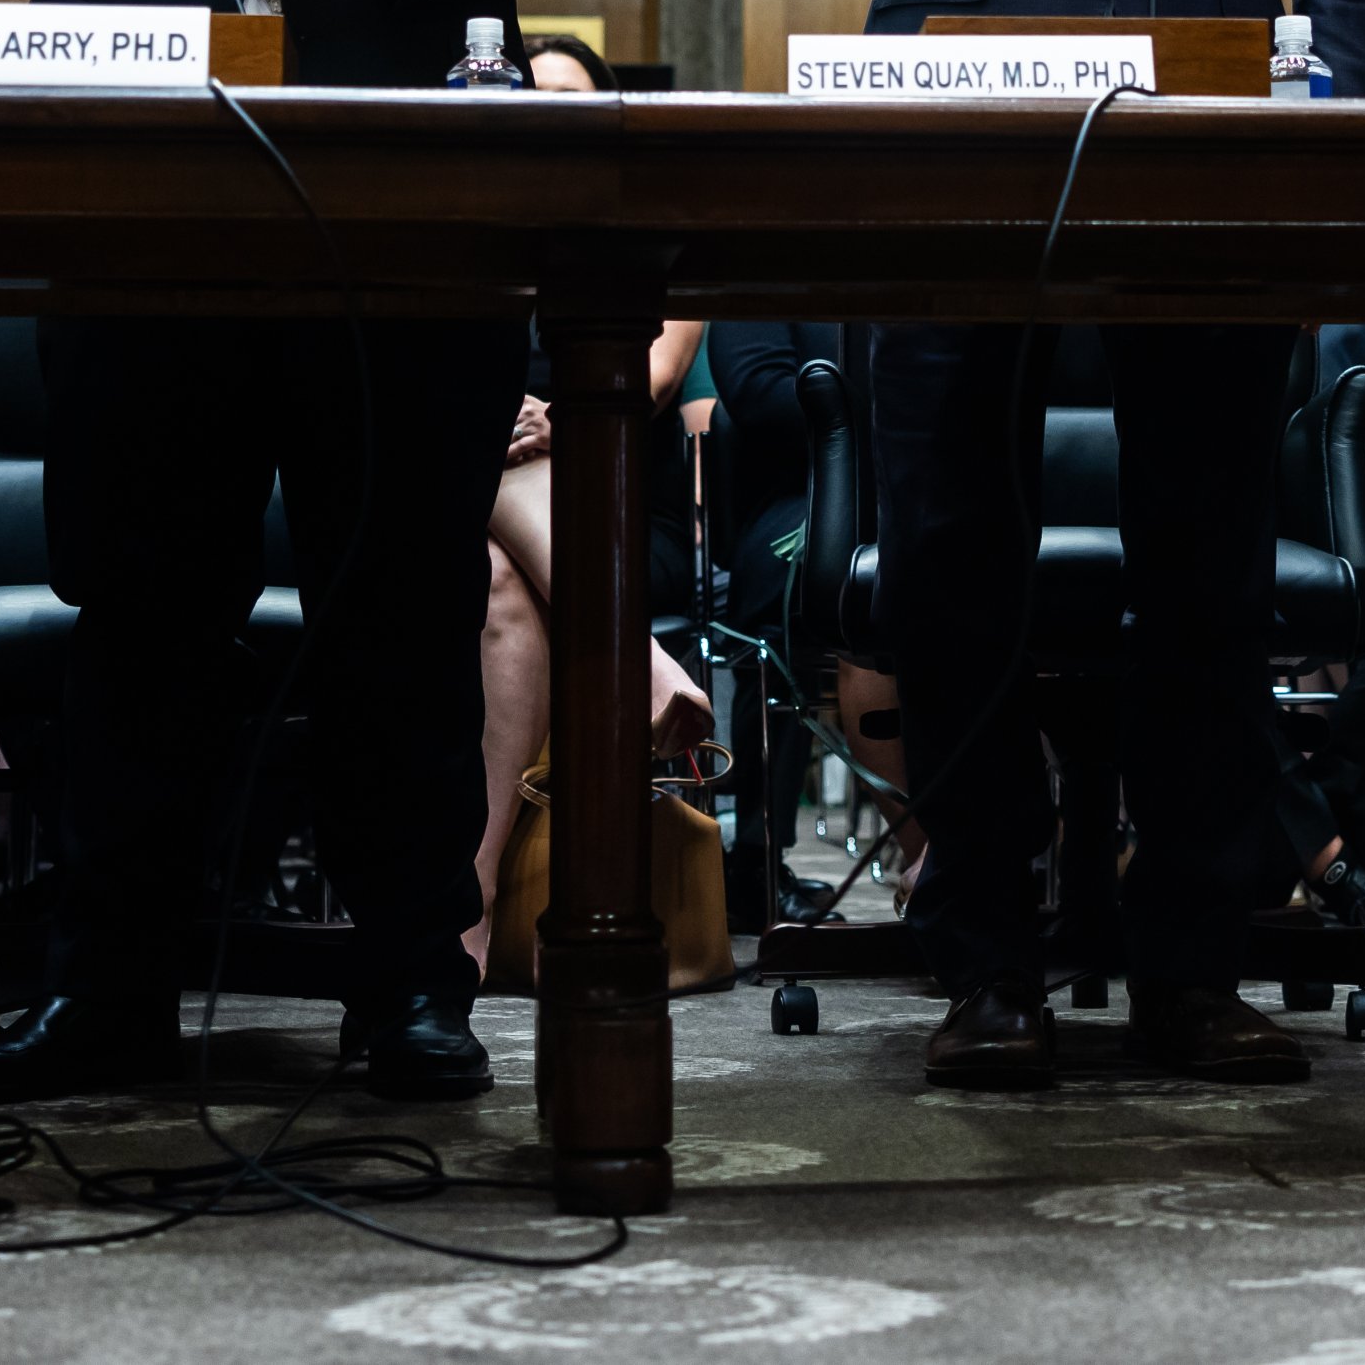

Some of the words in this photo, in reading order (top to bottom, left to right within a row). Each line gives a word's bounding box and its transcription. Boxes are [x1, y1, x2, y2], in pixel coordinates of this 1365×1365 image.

[112, 32, 197, 61] PH.D.
[797, 62, 904, 89] STEVEN
[914, 61, 992, 93] QUAY,
[1003, 62, 1065, 92] M.D.,
[1075, 61, 1145, 89] PH.D.
